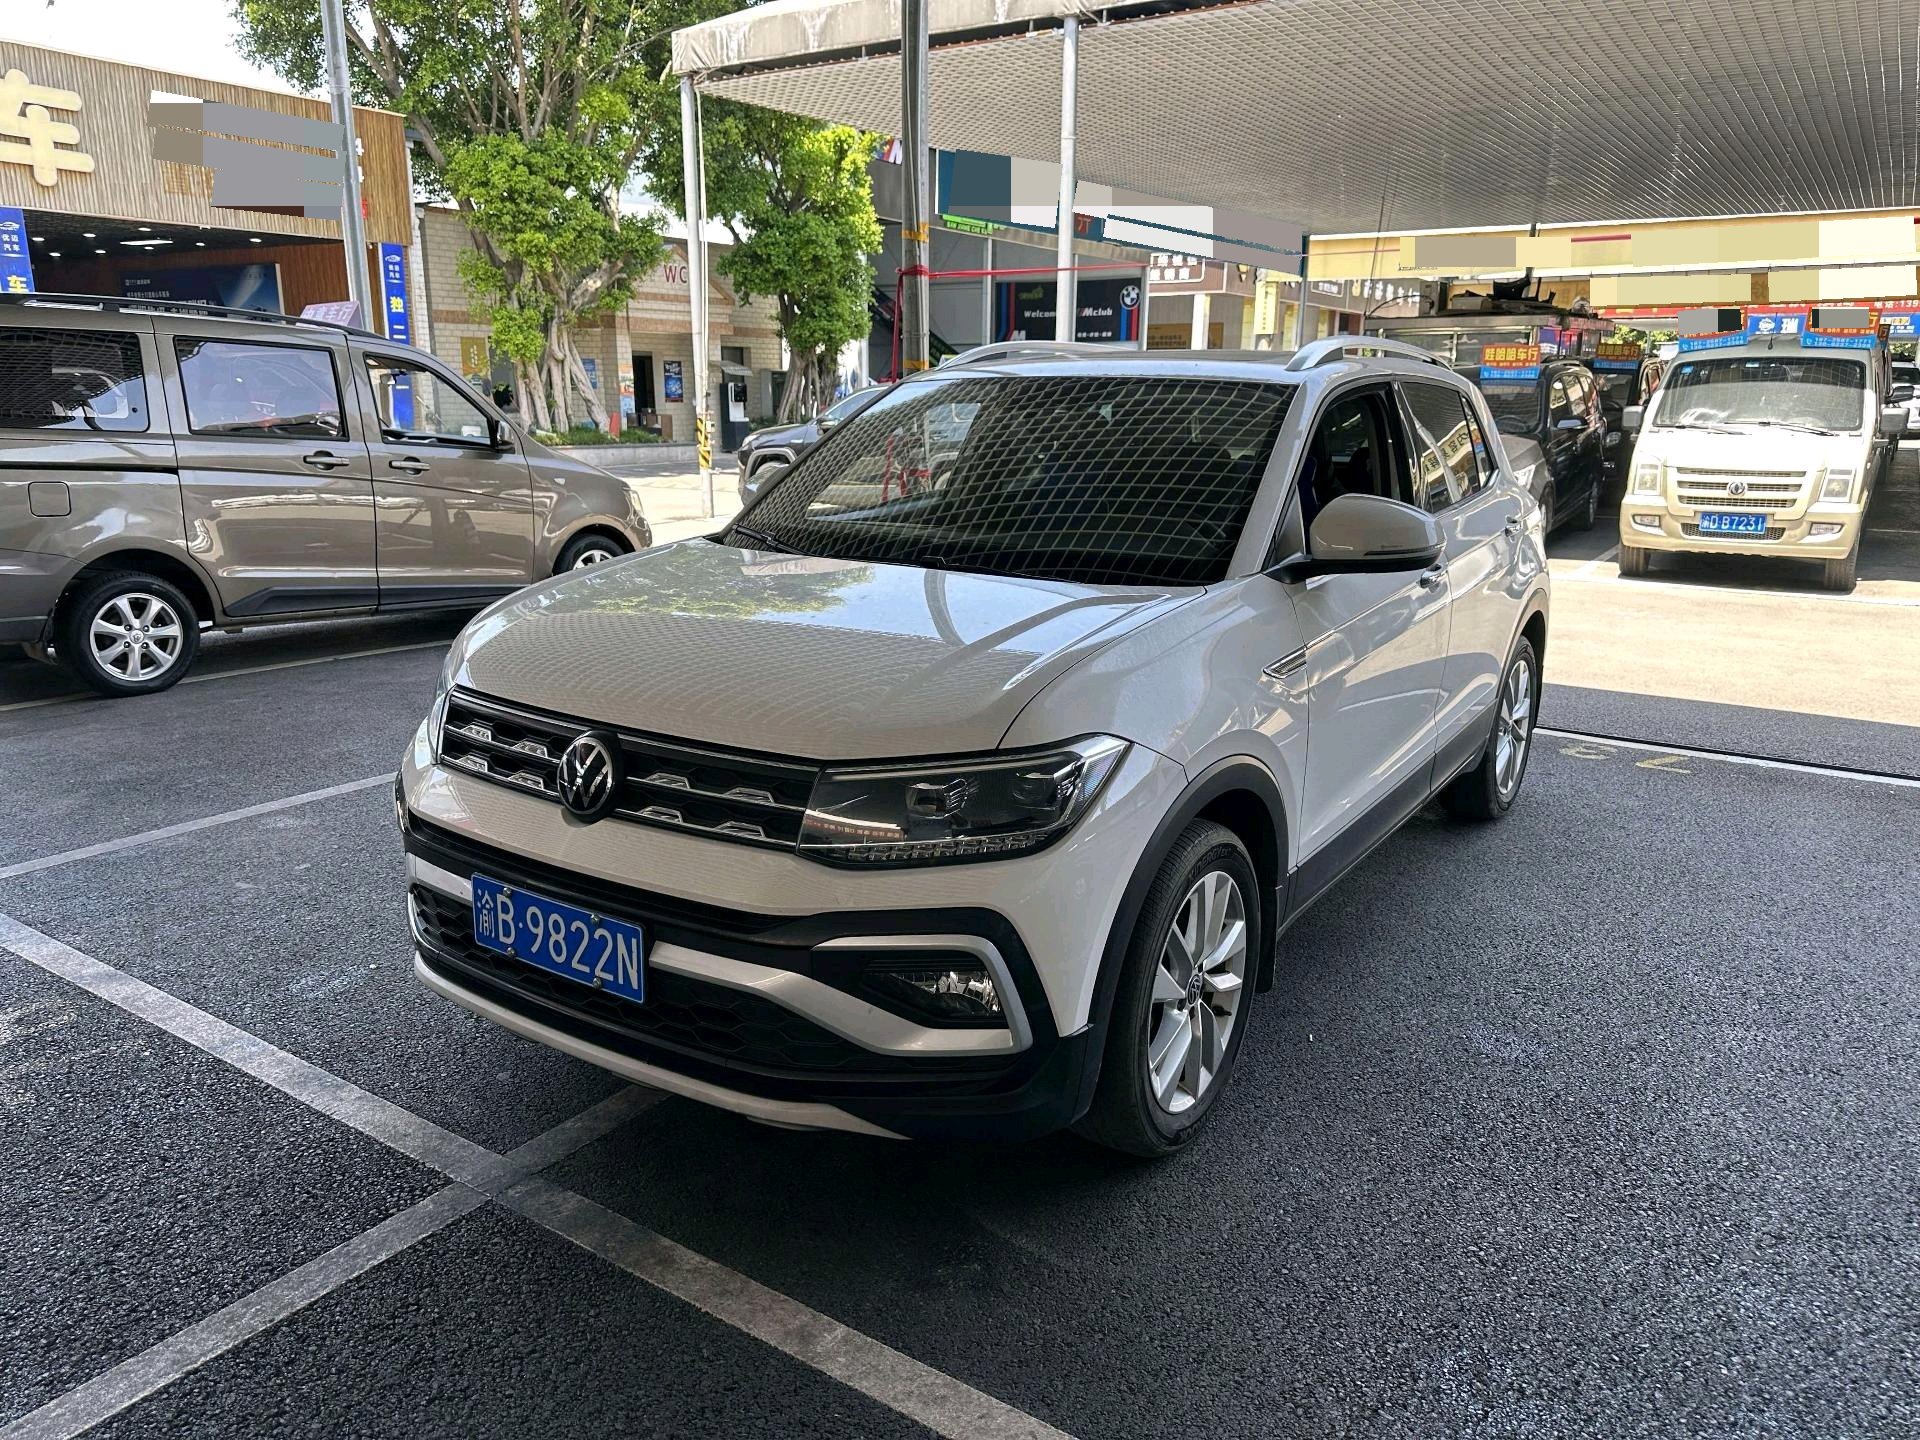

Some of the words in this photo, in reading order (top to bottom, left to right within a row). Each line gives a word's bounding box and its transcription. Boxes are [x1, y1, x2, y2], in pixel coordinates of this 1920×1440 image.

[0, 68, 95, 187] 车
[663, 264, 688, 283] WC
[1485, 347, 1538, 361] 娃哈哈车行
